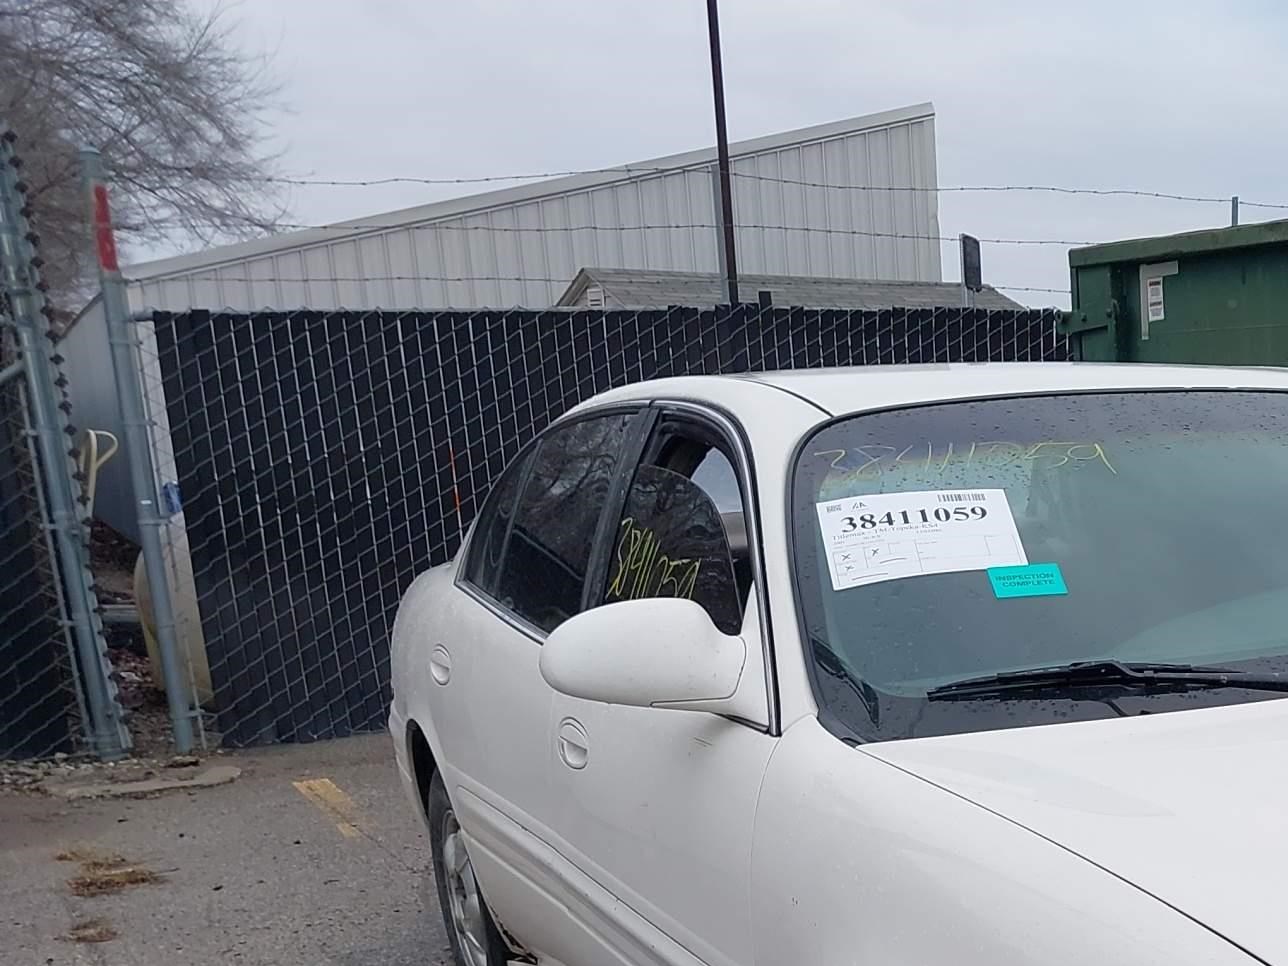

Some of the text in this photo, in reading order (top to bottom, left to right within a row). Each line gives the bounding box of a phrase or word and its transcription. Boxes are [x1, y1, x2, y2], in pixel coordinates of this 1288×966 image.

[840, 505, 988, 533] 38411059
[994, 572, 1055, 582] INSPECTION
[1001, 579, 1056, 588] COMPLETE
